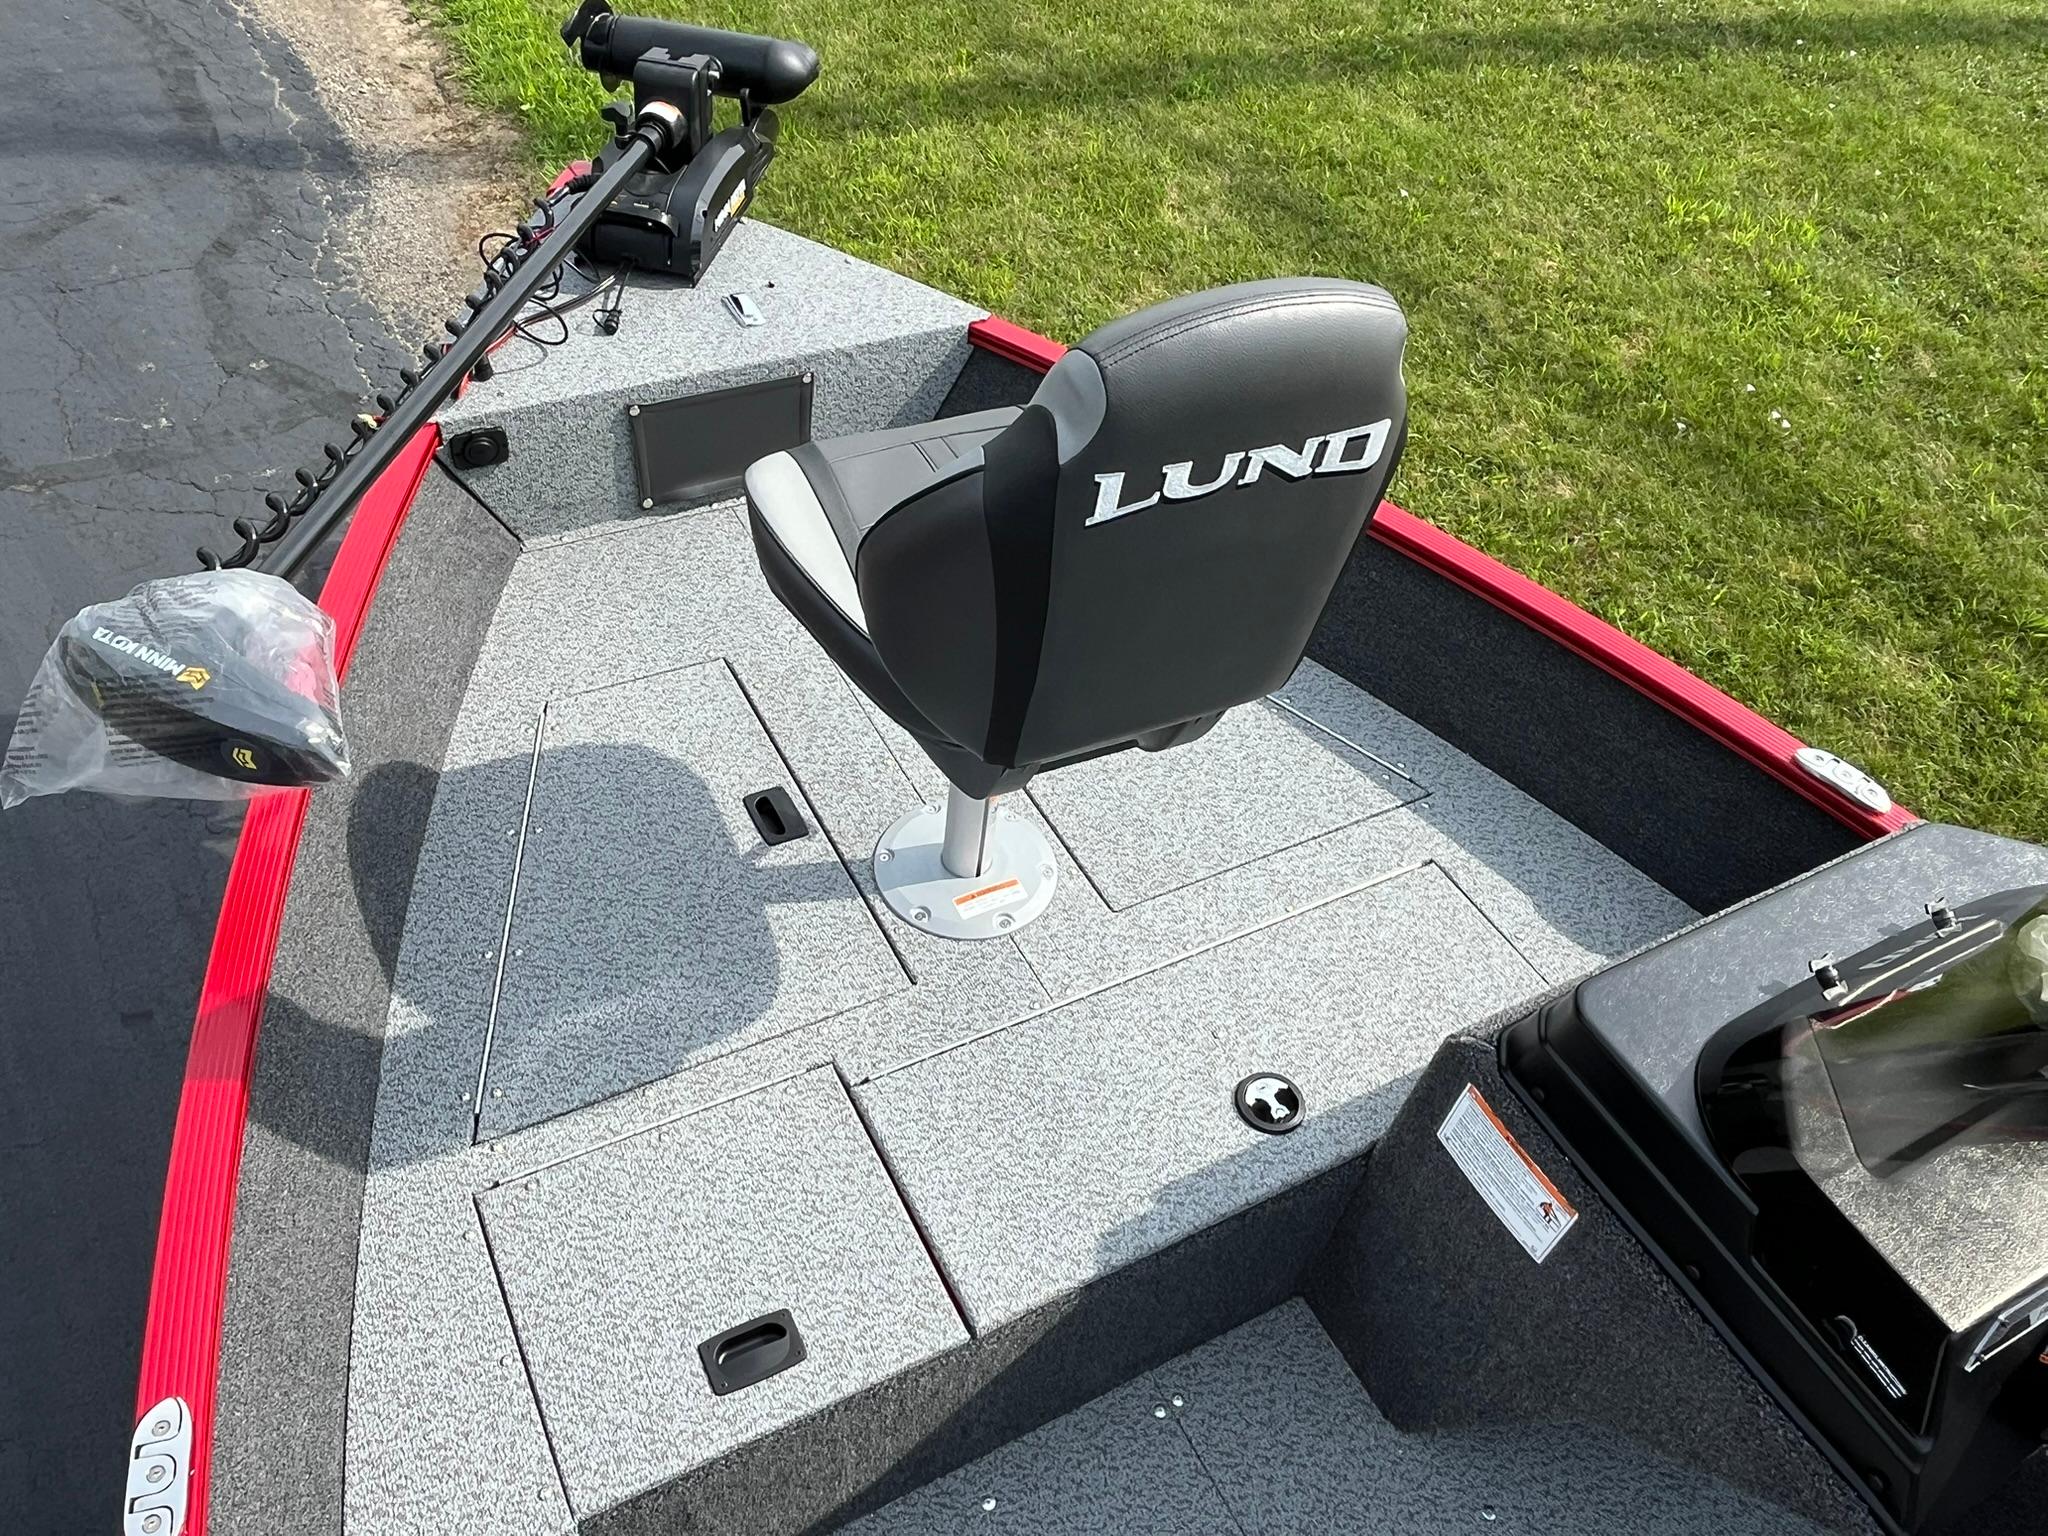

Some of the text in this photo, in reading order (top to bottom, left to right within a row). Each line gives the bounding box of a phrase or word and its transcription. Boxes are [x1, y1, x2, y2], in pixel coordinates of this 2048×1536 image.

[1085, 418, 1391, 527] LUND
[92, 626, 186, 676] MINN KOTA
